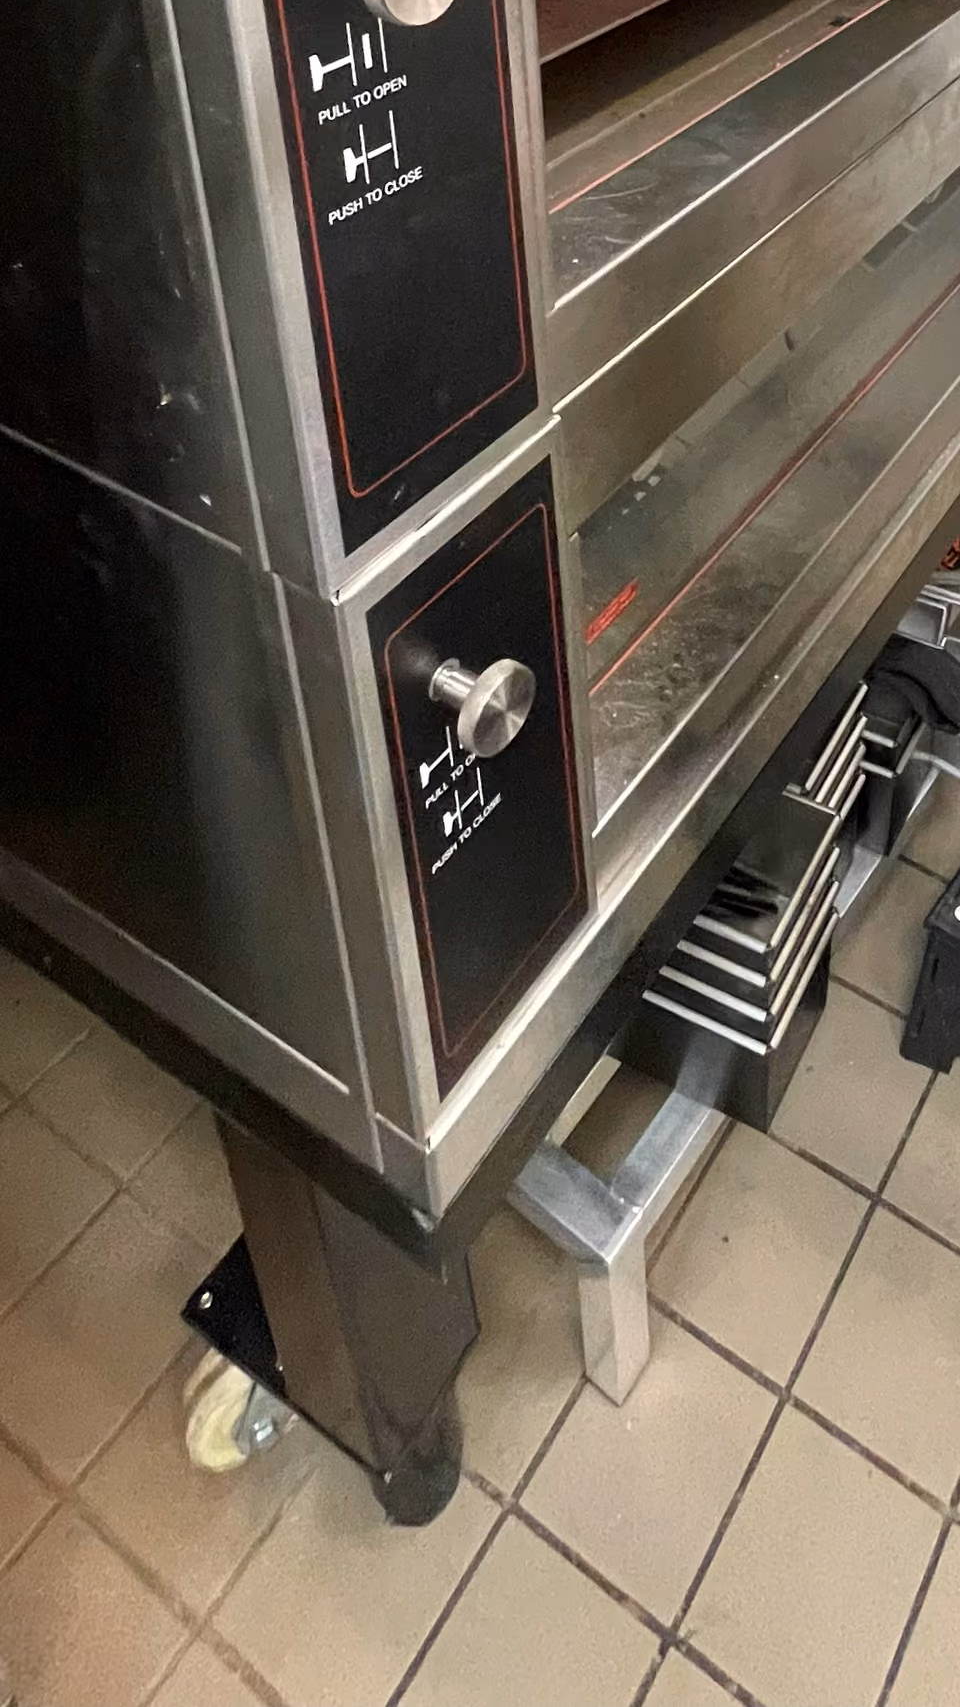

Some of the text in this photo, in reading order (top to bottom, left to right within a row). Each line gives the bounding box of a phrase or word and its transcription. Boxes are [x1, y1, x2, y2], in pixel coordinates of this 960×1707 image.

[318, 75, 408, 125] PULL TO OPEN
[328, 165, 424, 226] PUSH TO CLOSE
[425, 764, 464, 809] PULL TO
[431, 792, 502, 874] PUSH TO CLOSE
